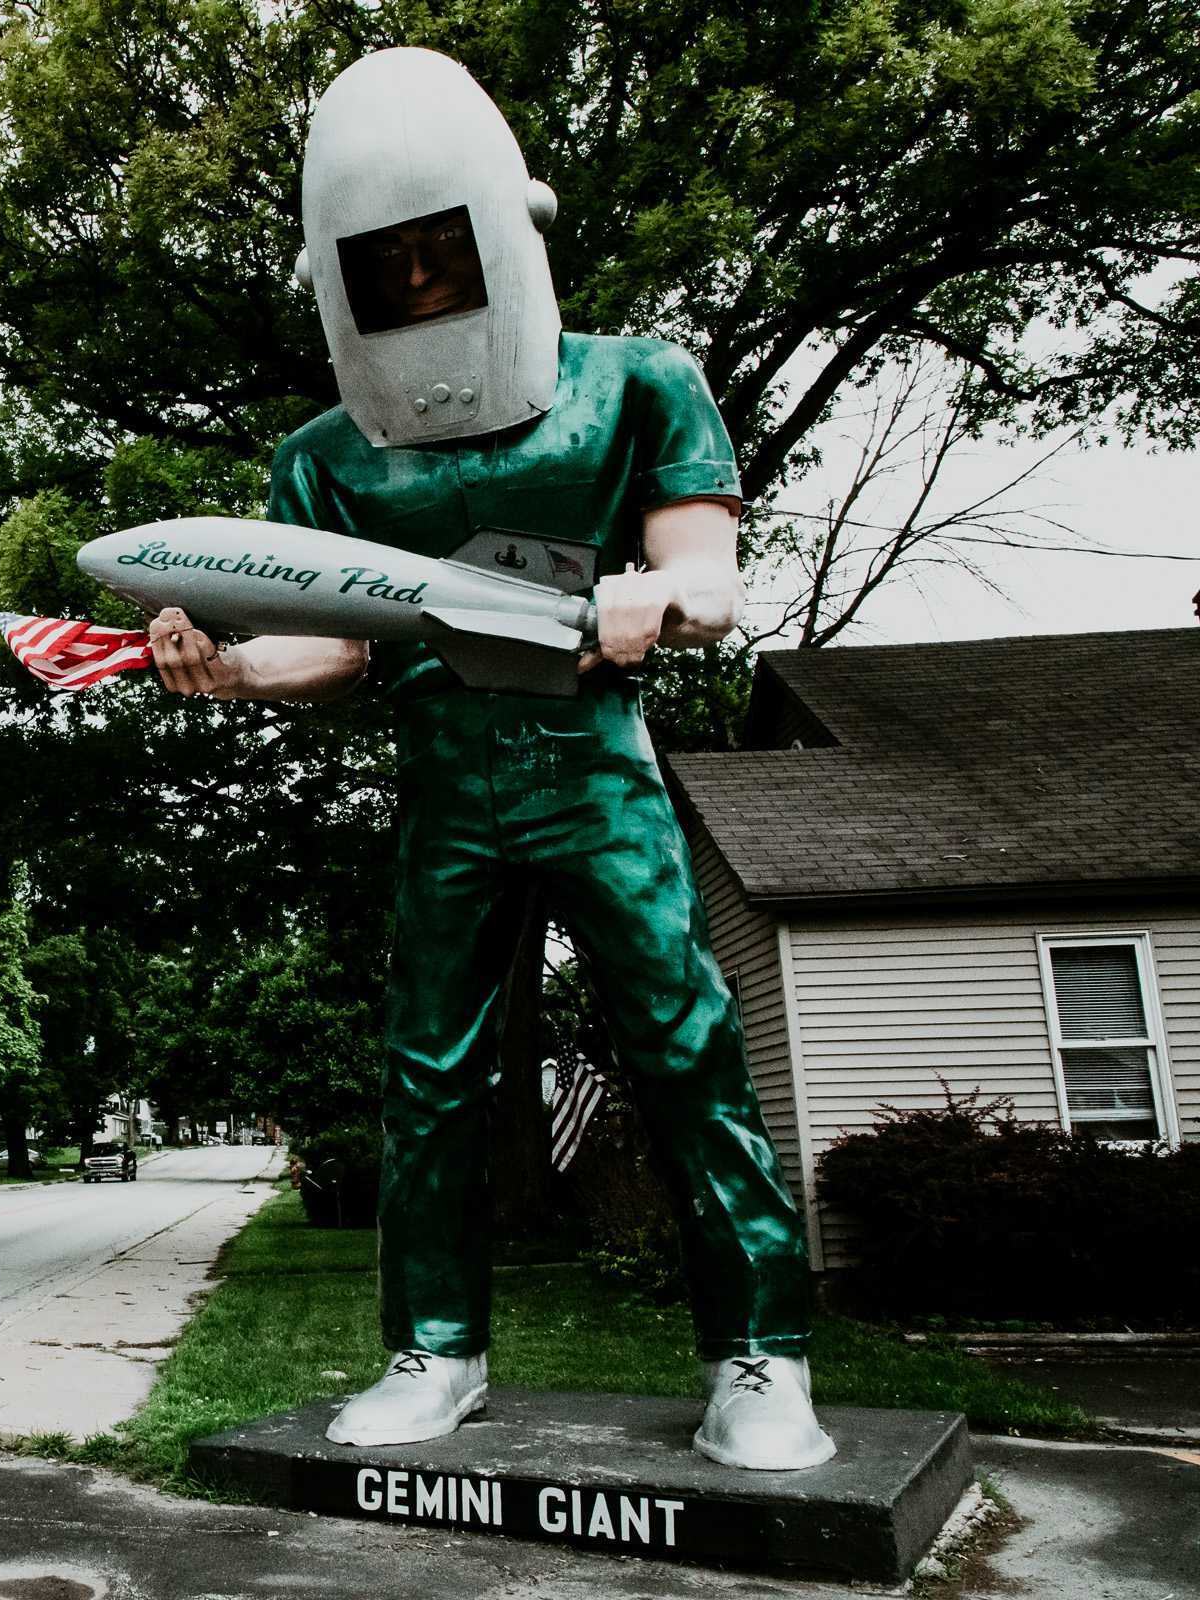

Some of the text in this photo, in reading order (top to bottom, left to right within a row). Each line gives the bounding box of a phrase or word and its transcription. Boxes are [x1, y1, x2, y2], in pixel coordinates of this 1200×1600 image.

[117, 541, 429, 604] Launching Pad
[356, 1468, 684, 1546] GEMINI GIANT
